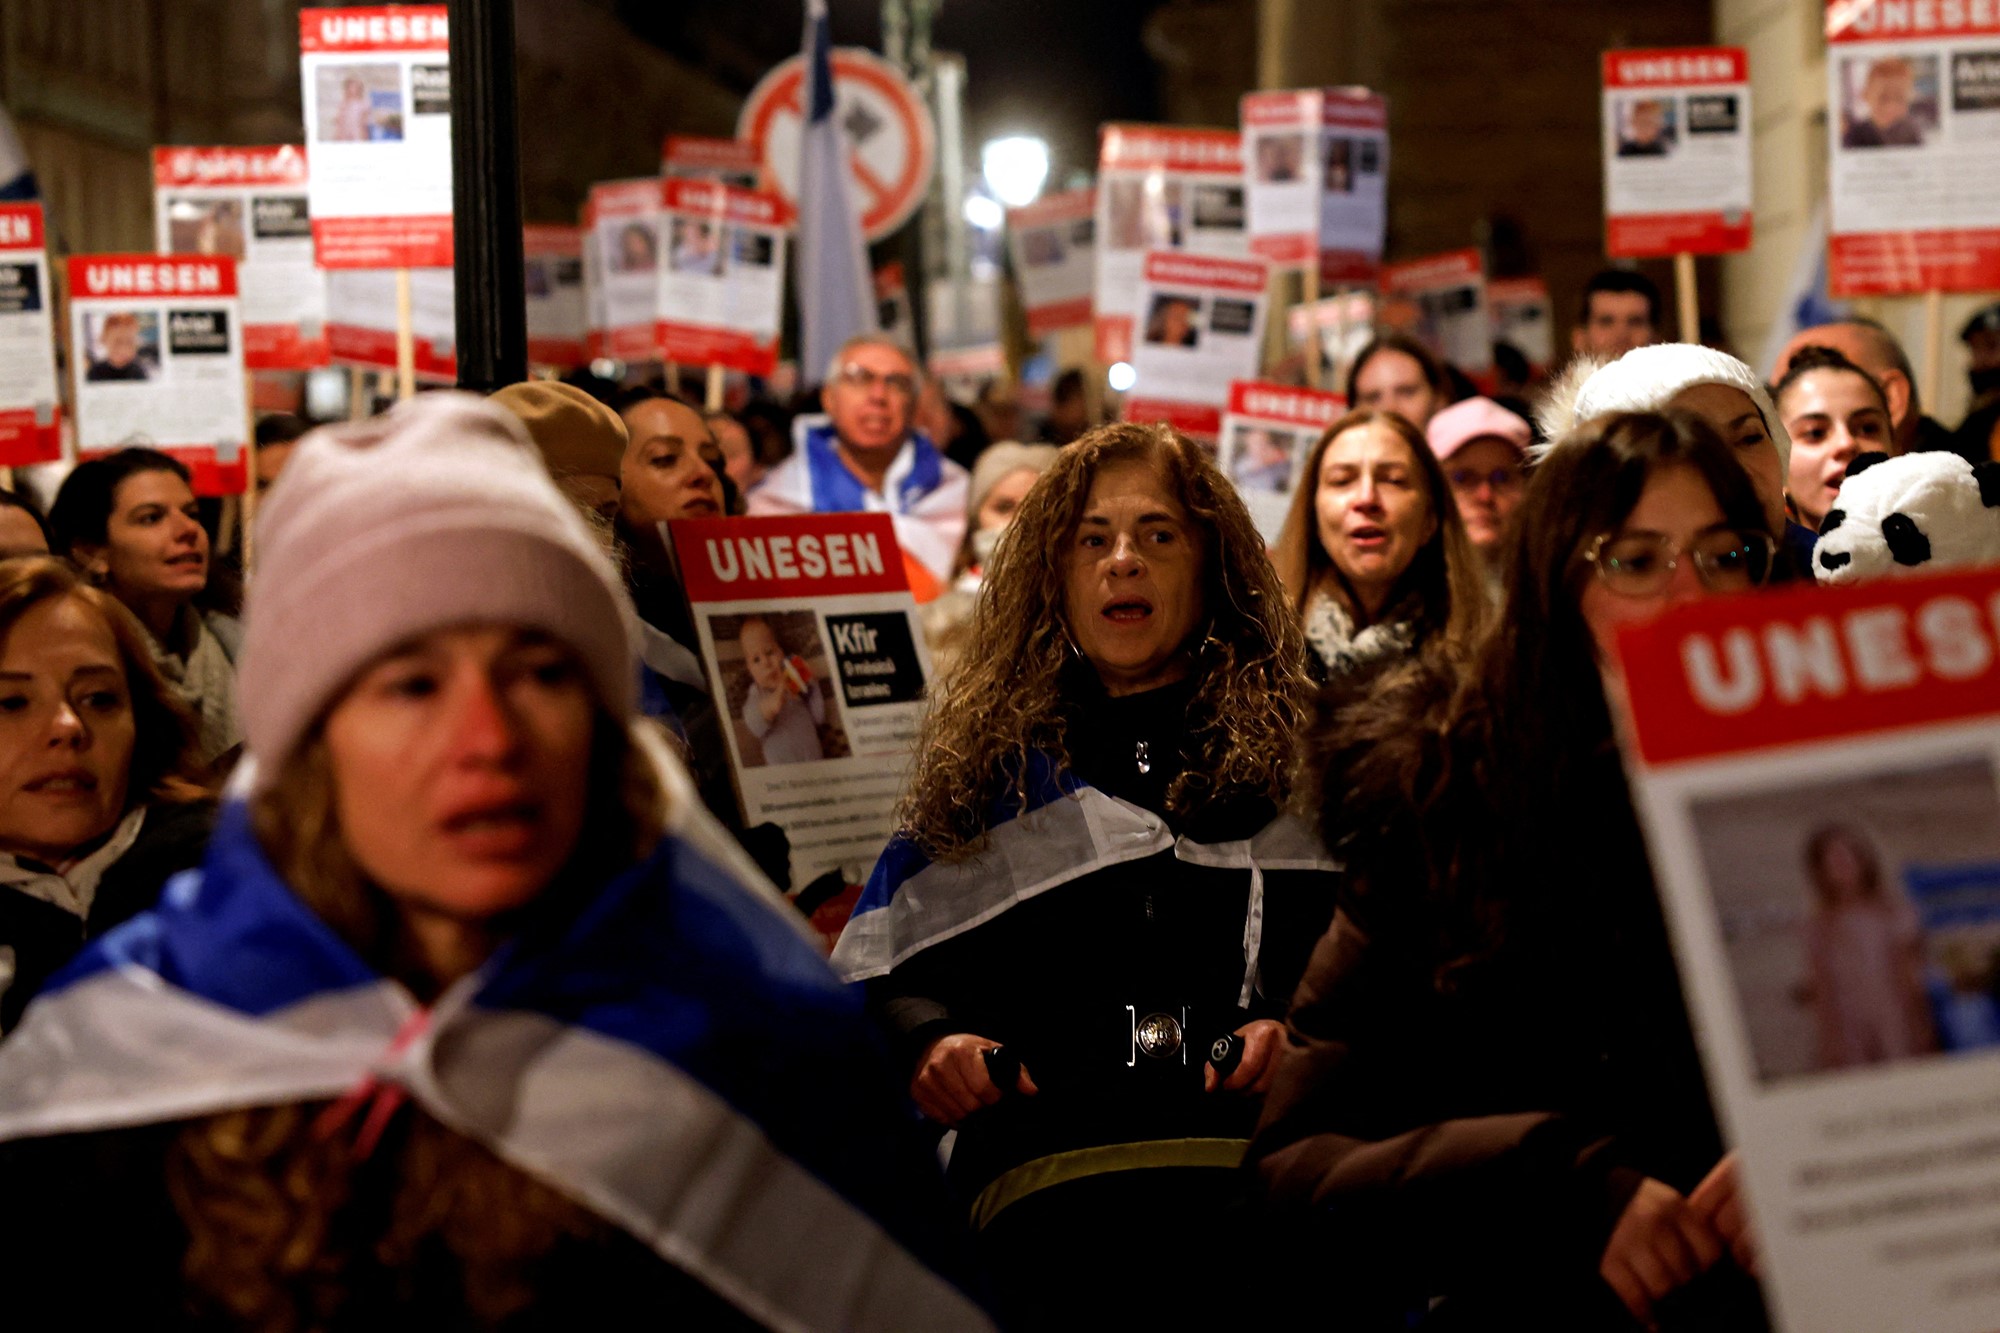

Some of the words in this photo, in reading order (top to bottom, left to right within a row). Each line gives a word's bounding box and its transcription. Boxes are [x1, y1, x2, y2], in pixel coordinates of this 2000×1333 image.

[85, 263, 221, 294] UNESEN
[705, 532, 885, 583] UNESEN
[832, 622, 878, 655] Kfir
[1679, 590, 2000, 716] UNES
